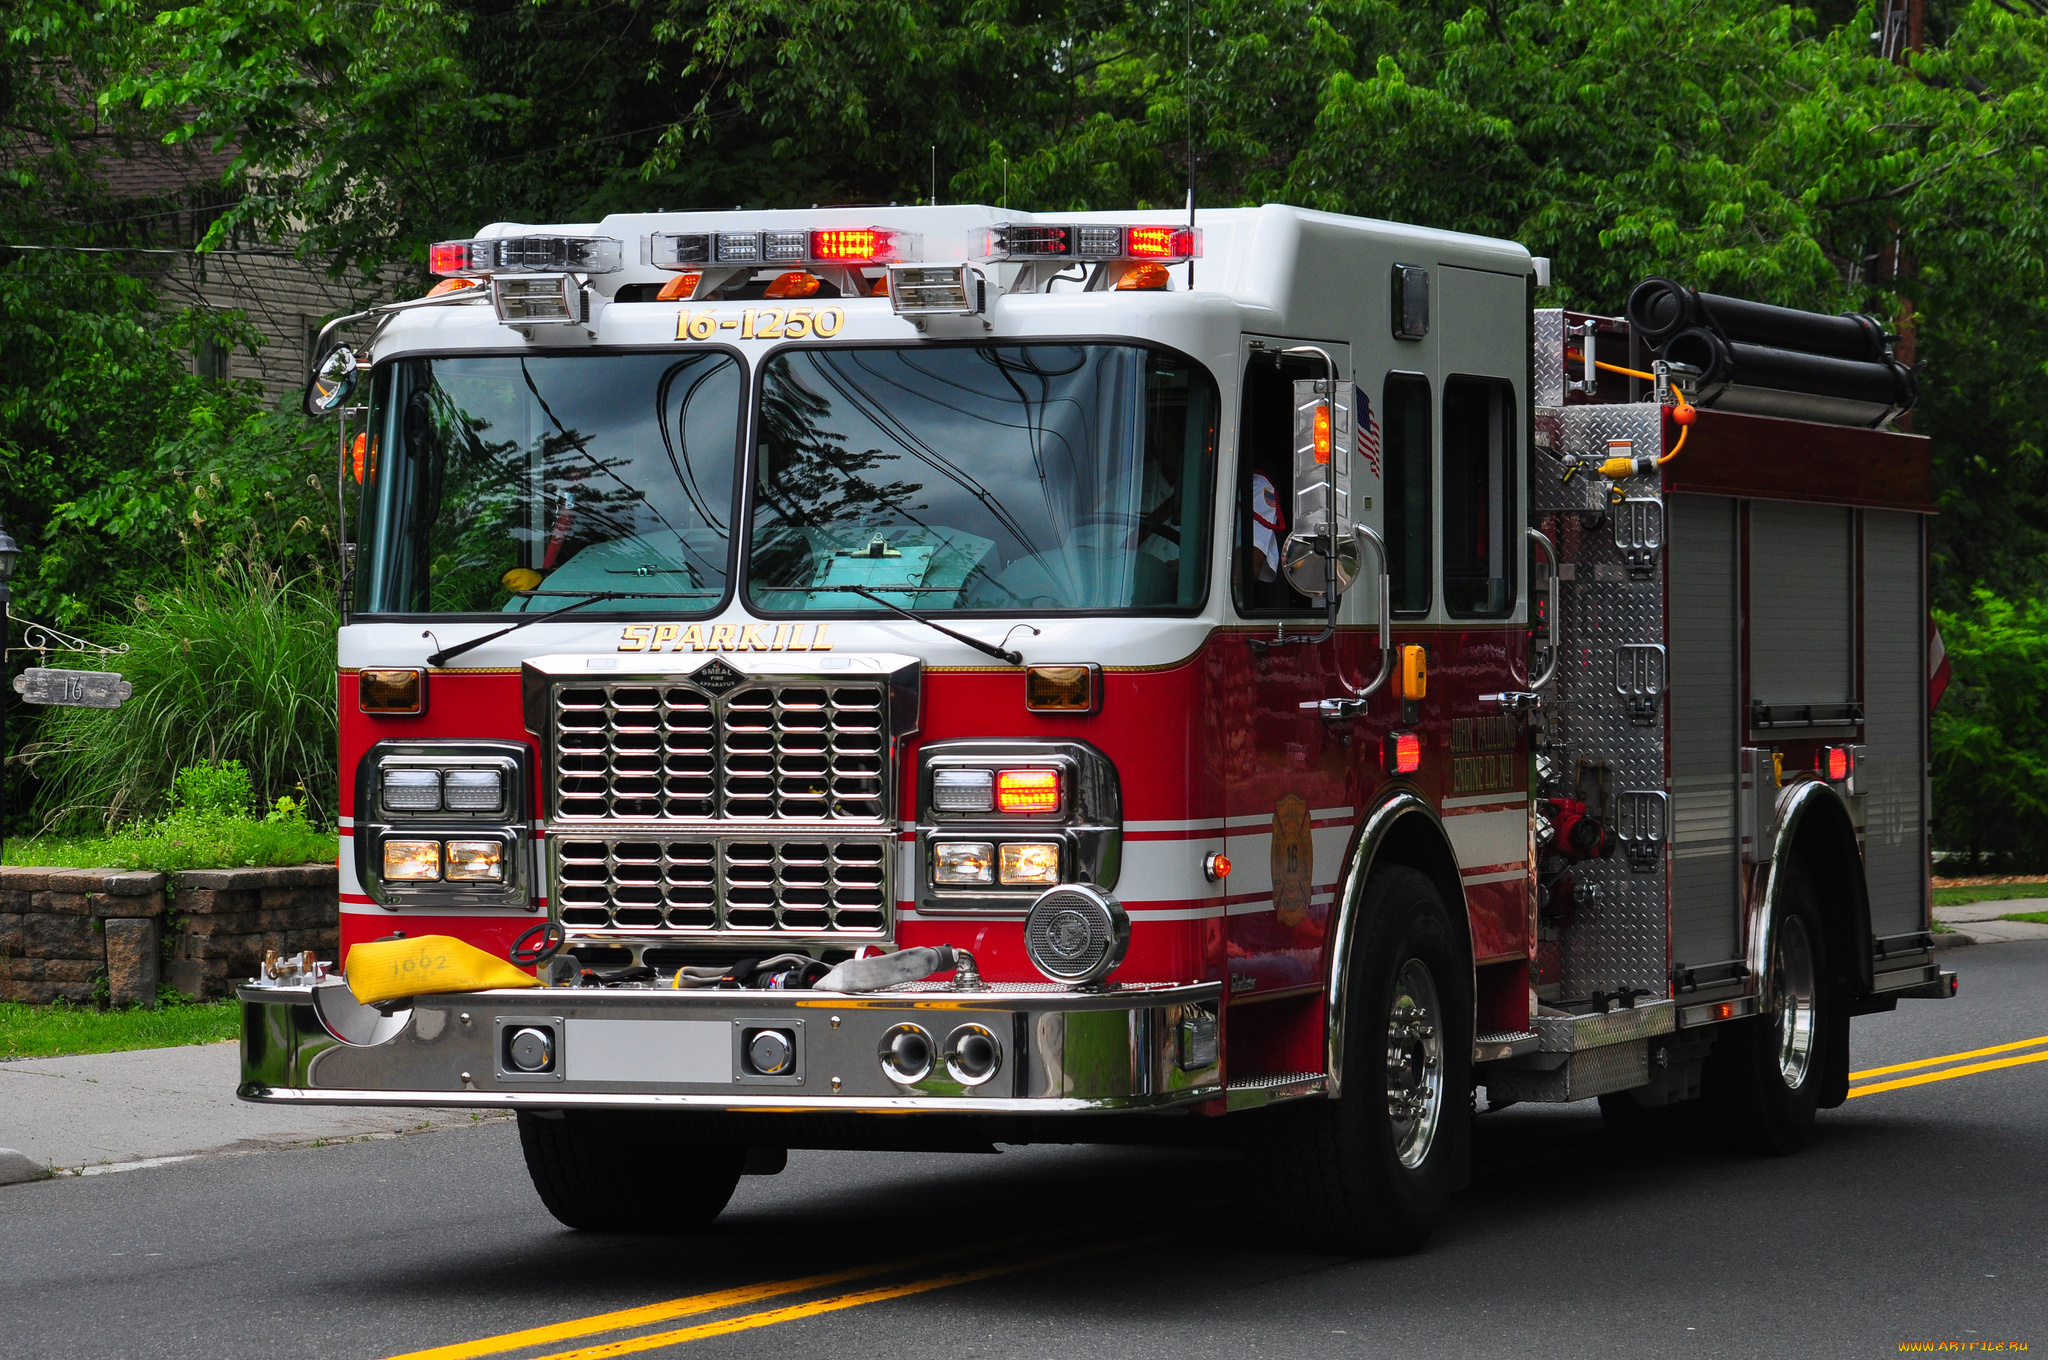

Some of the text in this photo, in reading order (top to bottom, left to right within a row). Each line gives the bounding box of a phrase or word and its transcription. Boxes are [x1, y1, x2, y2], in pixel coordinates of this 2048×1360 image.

[674, 306, 845, 341] 16-1250
[617, 623, 834, 652] SPARKILL
[702, 668, 733, 676] SMEAL
[63, 676, 83, 702] 16
[1286, 843, 1298, 874] 16
